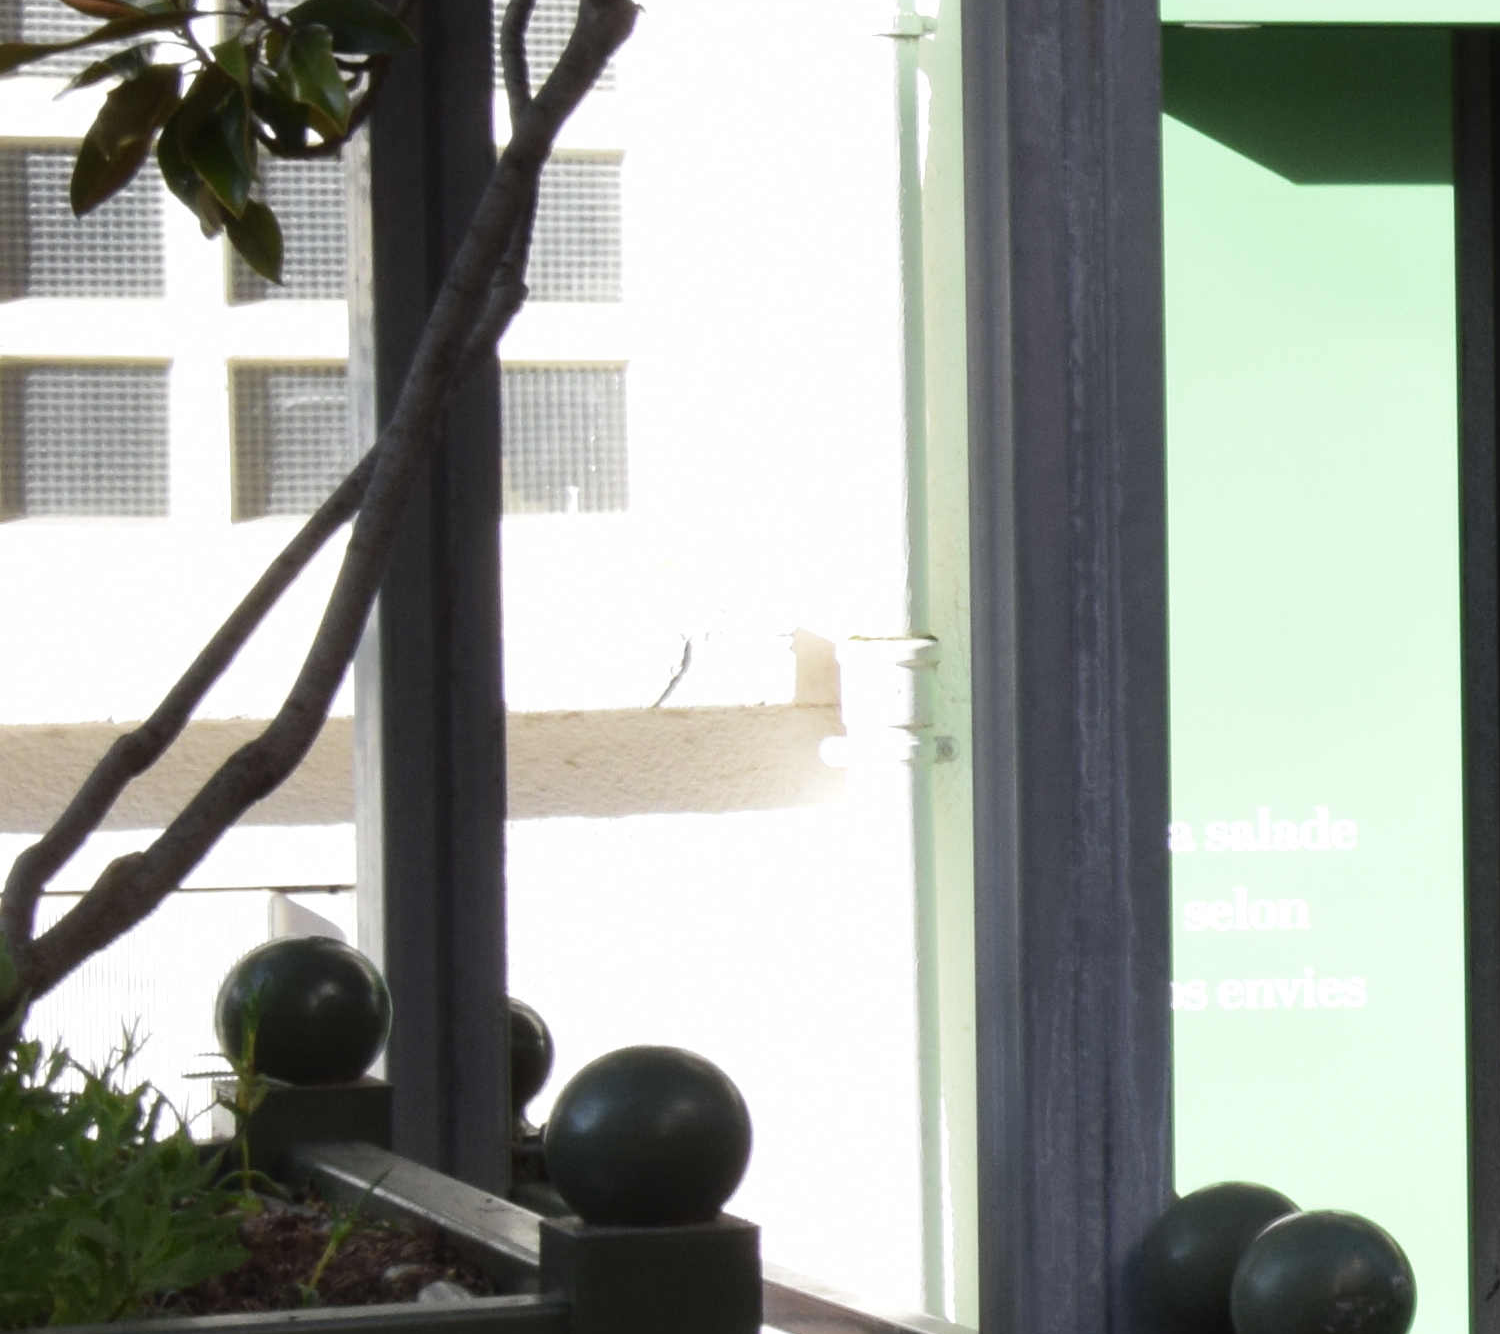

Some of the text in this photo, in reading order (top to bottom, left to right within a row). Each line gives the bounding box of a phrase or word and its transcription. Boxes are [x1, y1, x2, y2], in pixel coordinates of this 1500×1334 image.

[1205, 805, 1358, 852] salade
[1183, 886, 1311, 931] selon
[1216, 967, 1368, 1010] envies
